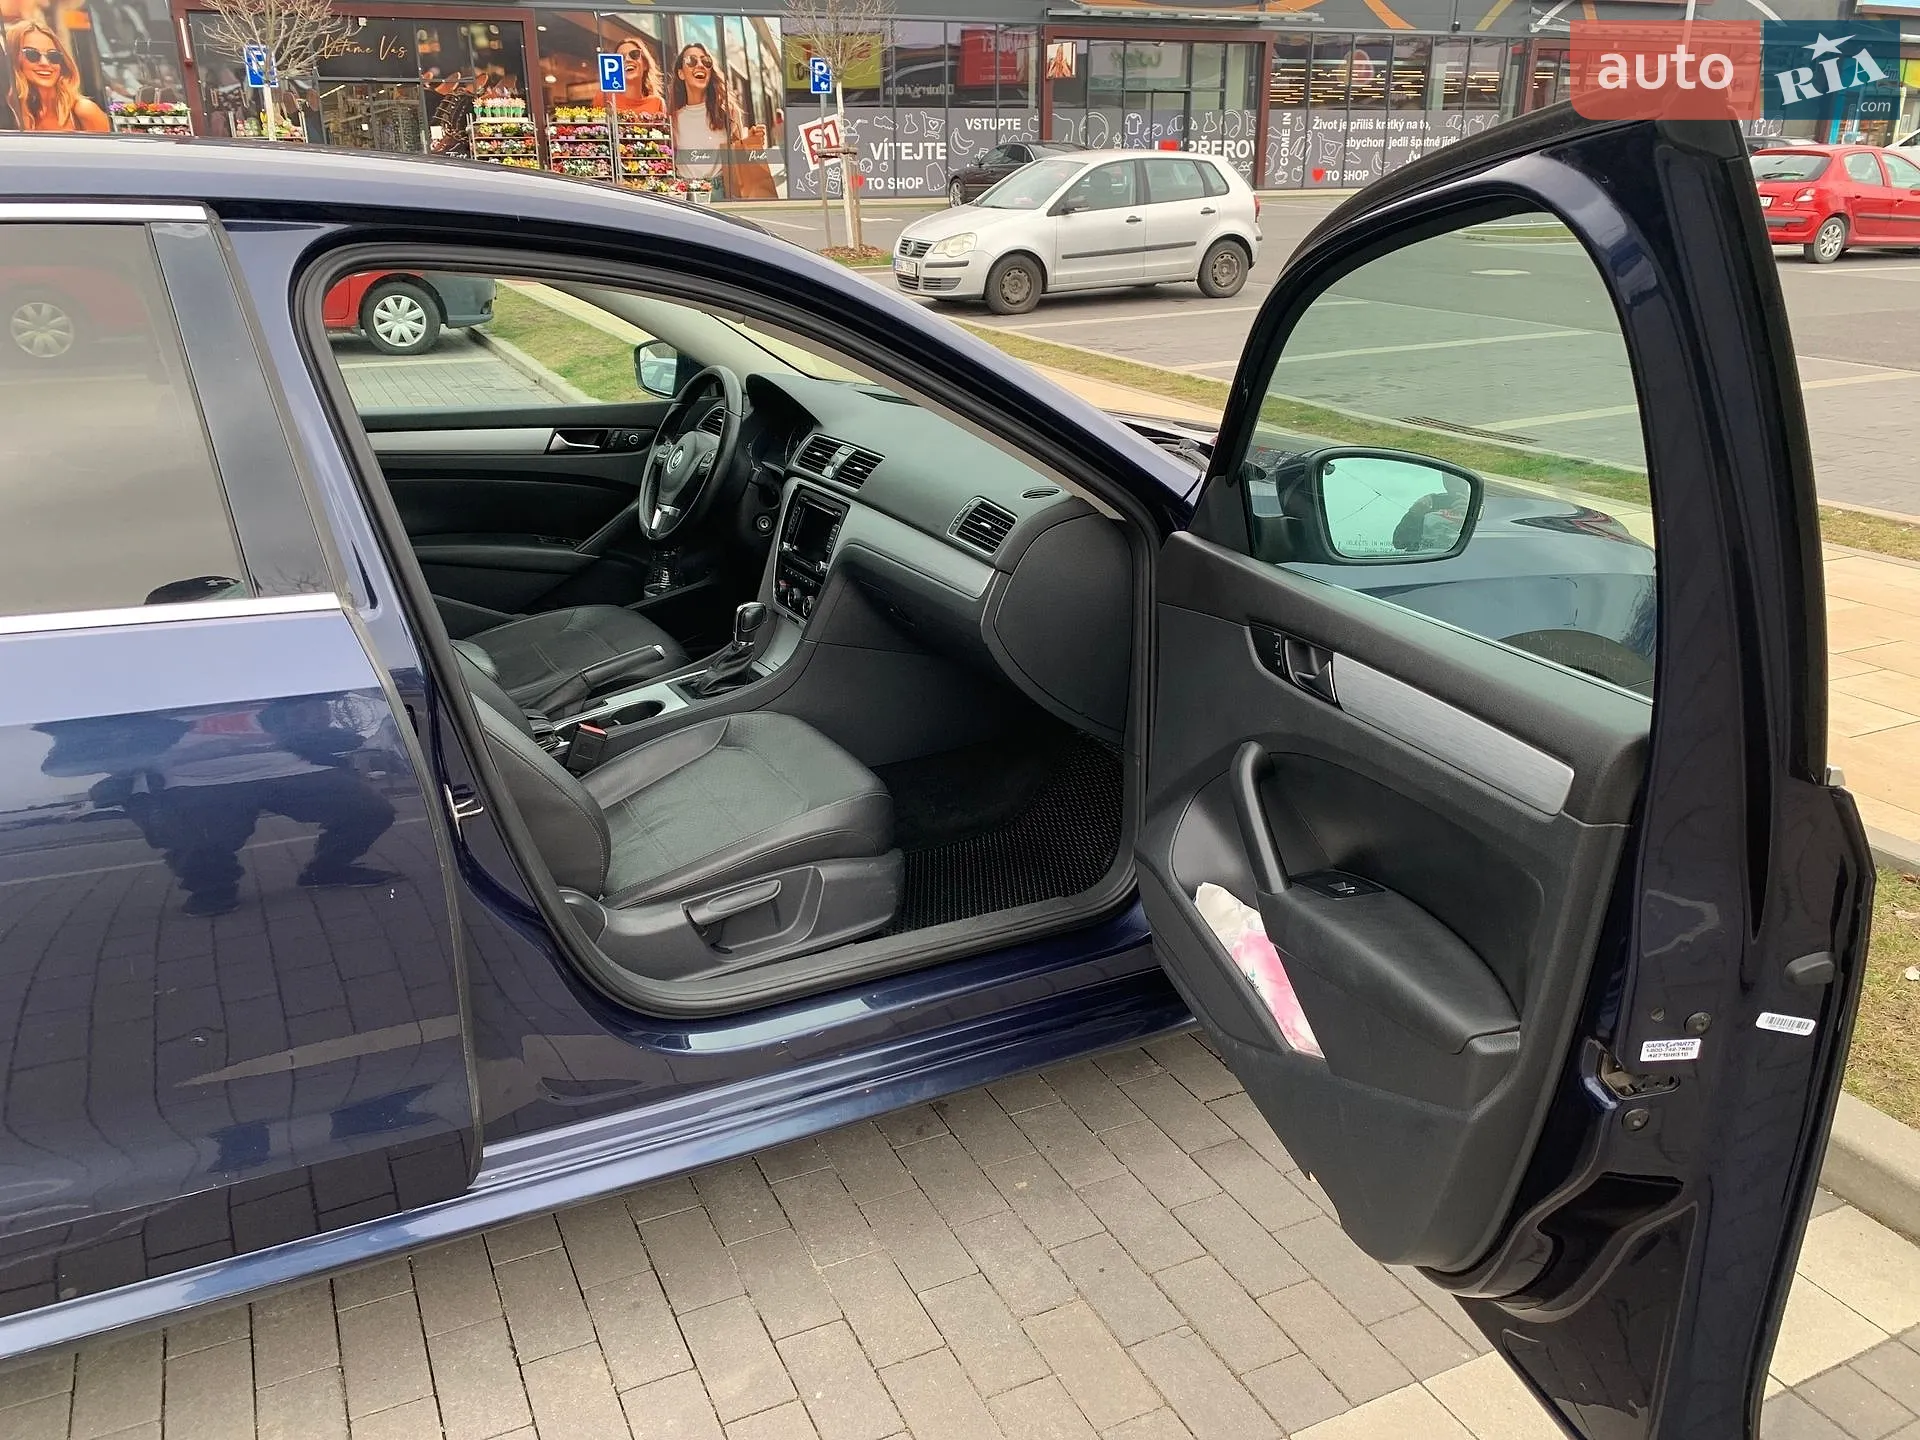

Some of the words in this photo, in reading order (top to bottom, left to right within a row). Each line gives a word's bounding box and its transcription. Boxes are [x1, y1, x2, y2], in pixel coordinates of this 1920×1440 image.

[603, 58, 619, 80] P
[814, 61, 827, 82] P
[965, 118, 1021, 130] VSTUPTE
[1282, 112, 1292, 125] IN
[1312, 116, 1338, 130] Život
[1338, 119, 1347, 132] je
[1350, 118, 1374, 132] příliš
[1406, 121, 1418, 130] na
[869, 138, 947, 161] VÍTEJTE
[1280, 128, 1291, 166] COME
[1388, 136, 1409, 149] jedli
[866, 177, 885, 190] TO
[887, 176, 924, 190] SHOP
[1325, 170, 1340, 181] TO
[1343, 170, 1369, 181] SHOP
